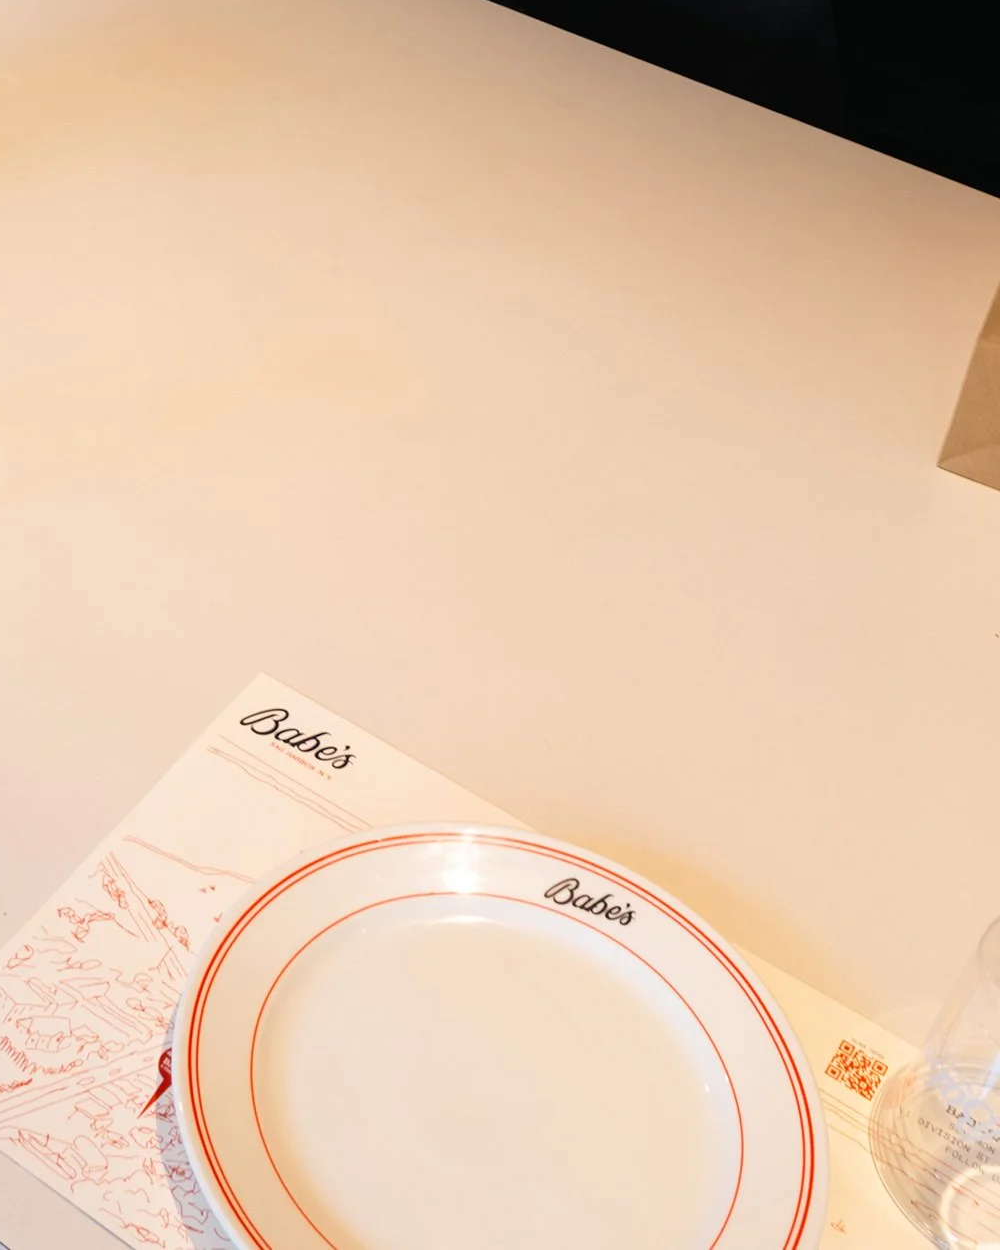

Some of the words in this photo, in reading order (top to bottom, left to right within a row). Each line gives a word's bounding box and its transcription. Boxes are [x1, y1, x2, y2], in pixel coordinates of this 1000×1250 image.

[240, 708, 356, 769] Babe's
[544, 877, 636, 926] Babe's
[917, 1117, 972, 1153] DIVISION
[945, 1145, 985, 1175] FOLLO
